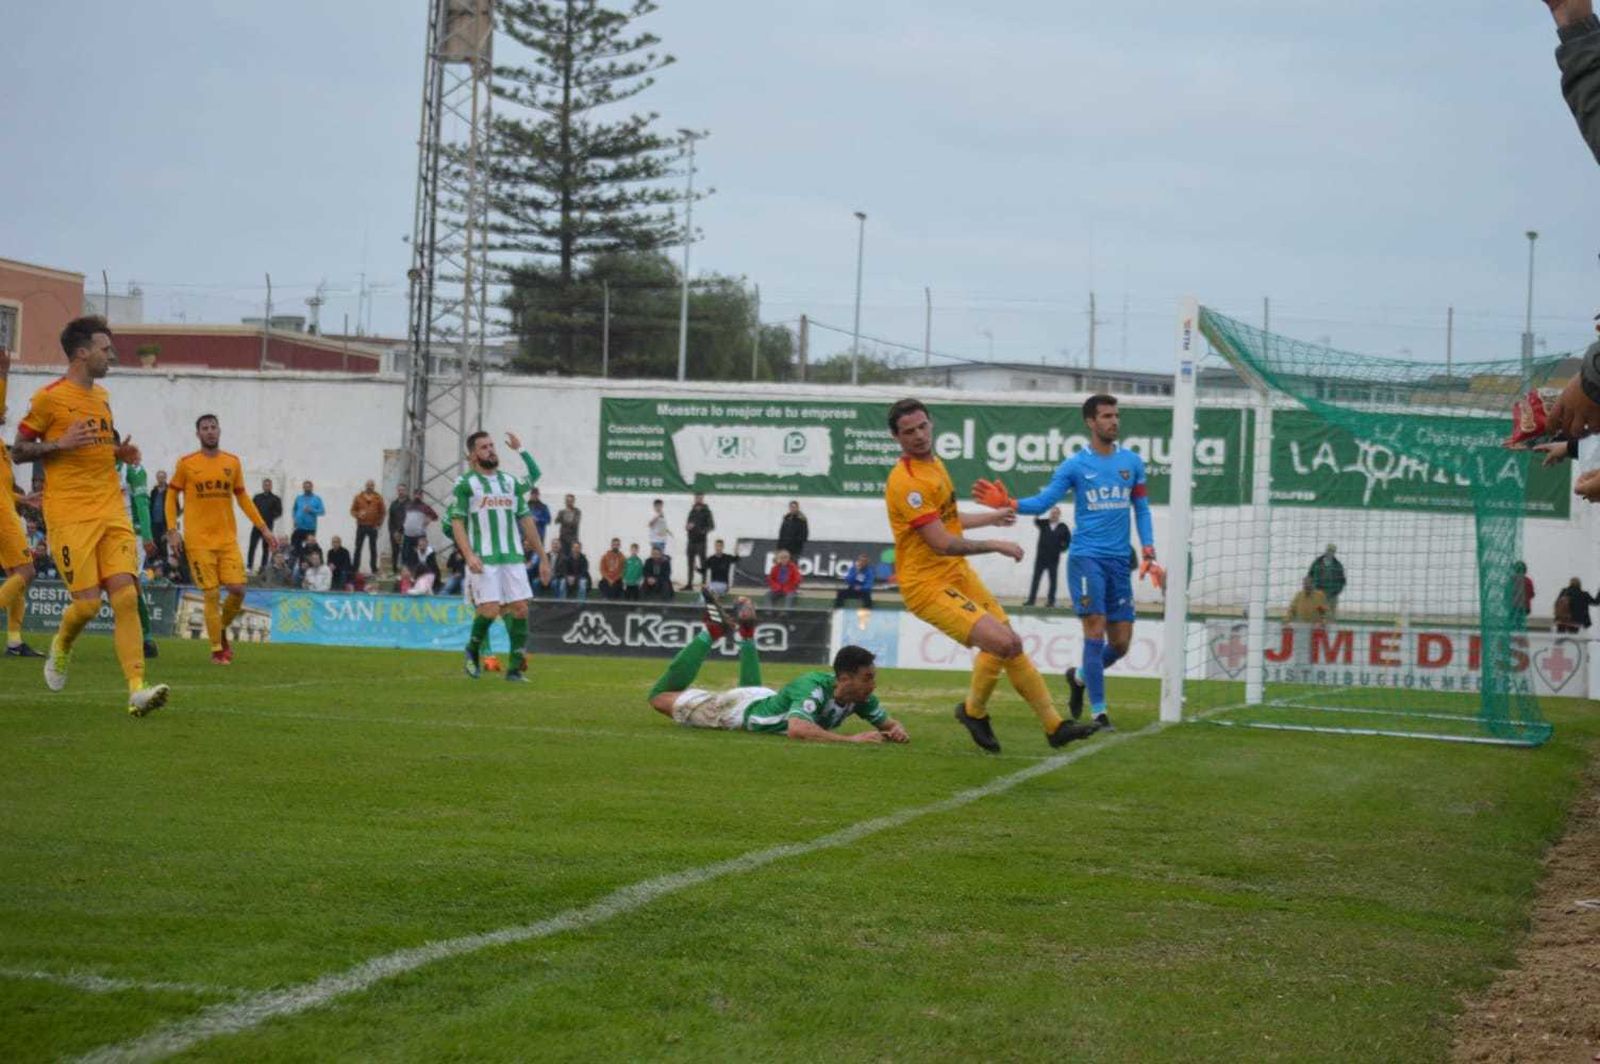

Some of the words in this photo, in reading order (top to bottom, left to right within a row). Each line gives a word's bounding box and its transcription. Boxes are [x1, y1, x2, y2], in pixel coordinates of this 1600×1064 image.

[657, 404, 708, 416] Muestra
[710, 406, 722, 416] lo
[726, 407, 763, 419] mejor
[766, 406, 782, 417] de
[785, 407, 798, 418] tu
[801, 409, 857, 420] empresa
[936, 419, 975, 459] el
[607, 451, 663, 461] empresas
[844, 454, 896, 465] Laborale
[62, 545, 71, 567] 8
[1082, 576, 1088, 596] 1
